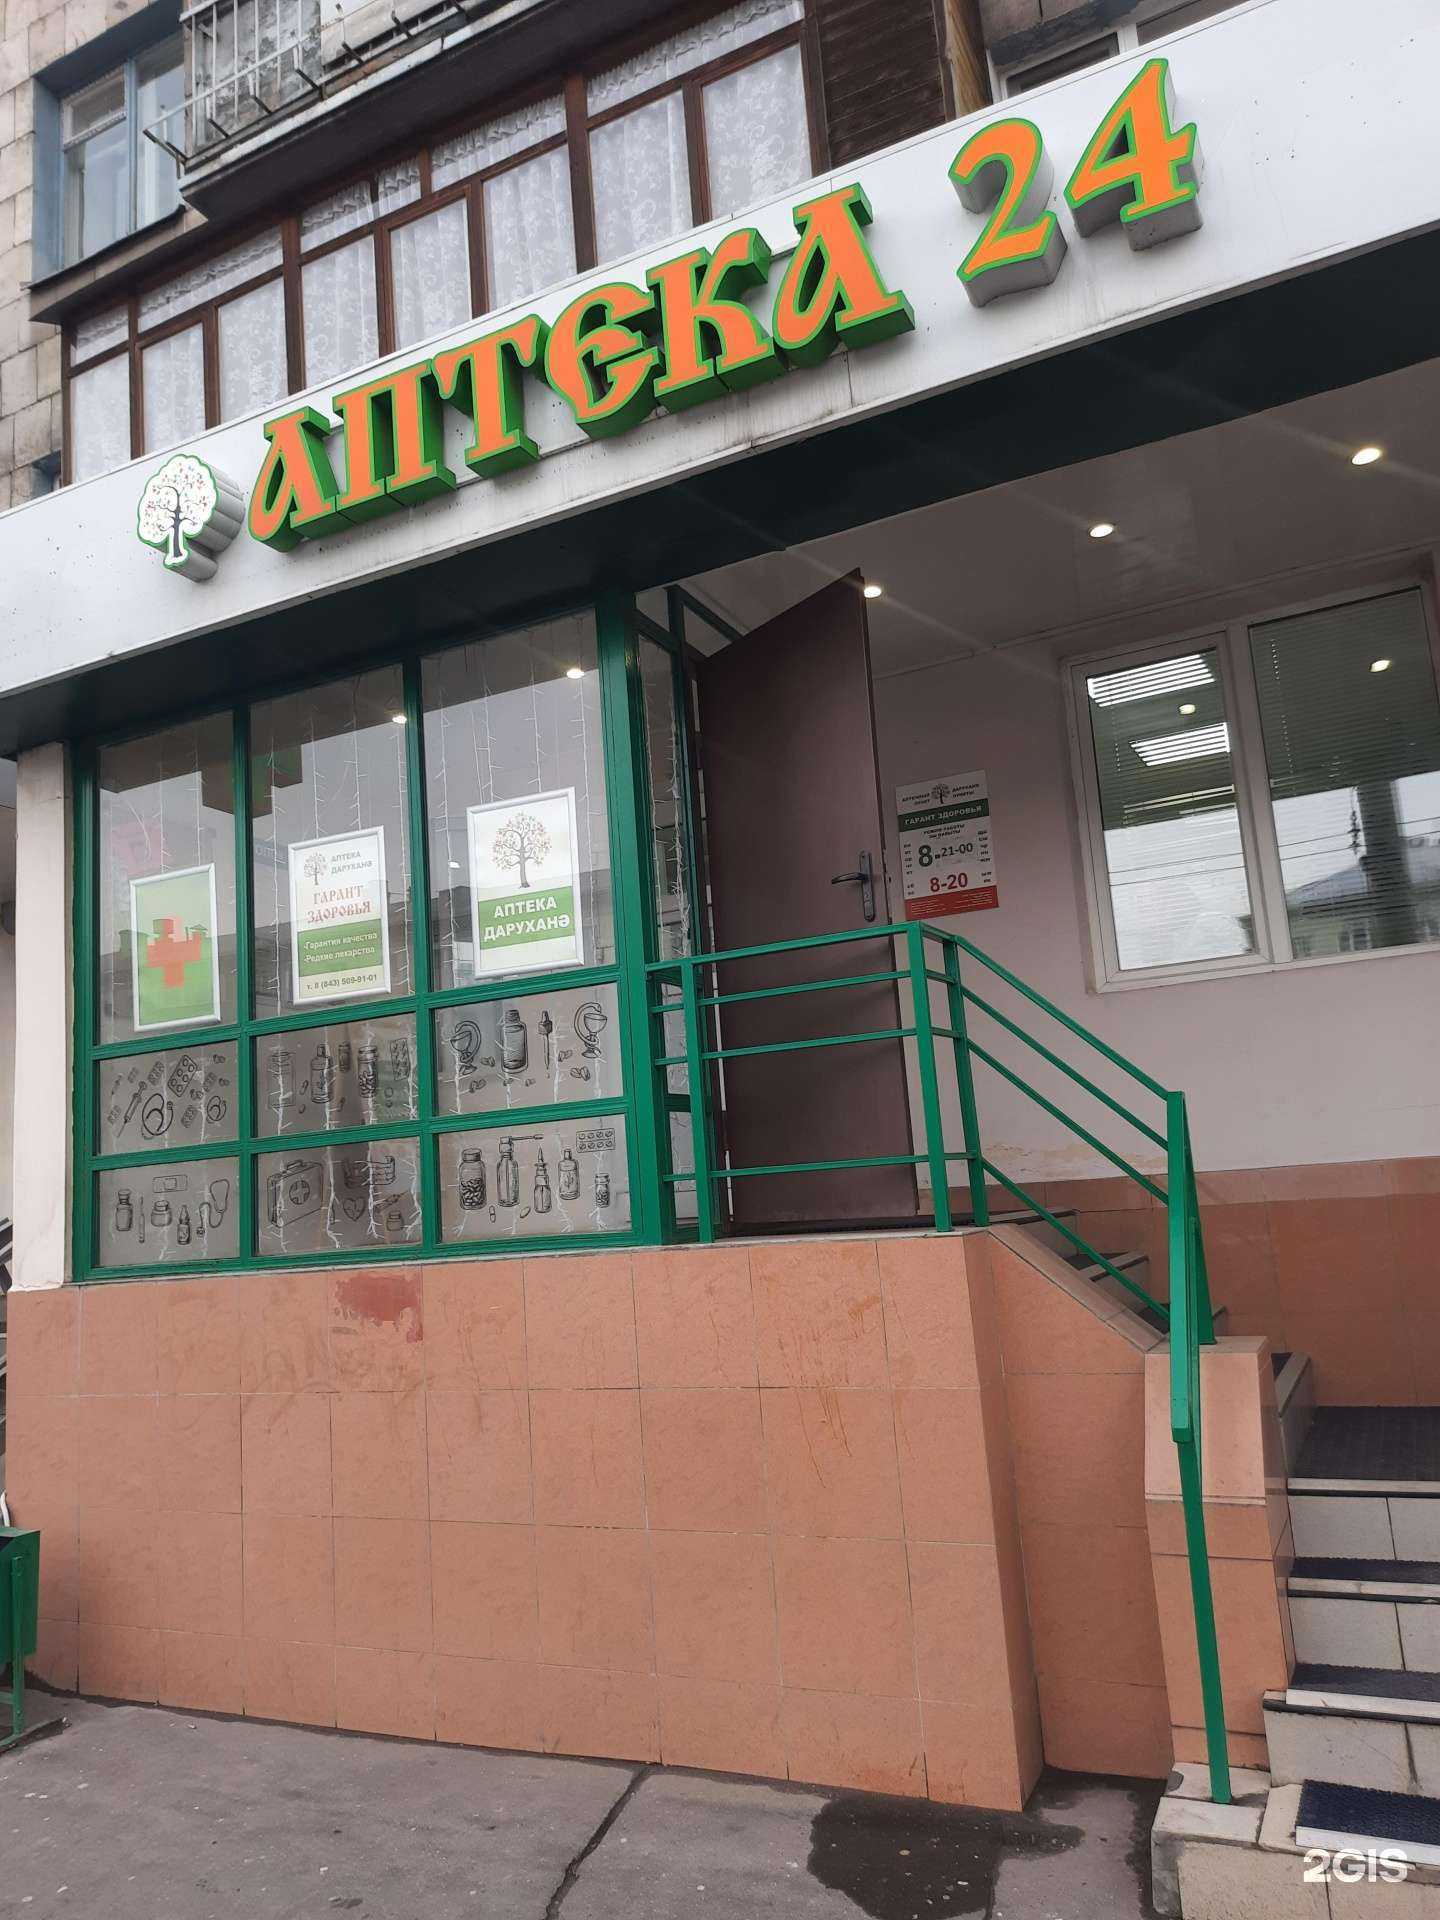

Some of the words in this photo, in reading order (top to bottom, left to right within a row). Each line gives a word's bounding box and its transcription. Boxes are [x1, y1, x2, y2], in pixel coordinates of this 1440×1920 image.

[248, 182, 911, 550] АПТЕКА
[948, 57, 1200, 302] 24
[904, 814, 935, 825] ГАРАНТ
[938, 805, 982, 820] ЗДОРОВЬЯ
[331, 851, 361, 863] АПТЕКА
[331, 860, 373, 875] ДАРУХАНӘ
[930, 872, 968, 892] 8-20
[313, 885, 364, 905] ГАРАНТ
[307, 900, 372, 923] ЗДОРОВЬЯ
[494, 896, 557, 919] АПТЕКА
[484, 914, 570, 942] ДАРУХАНӘ
